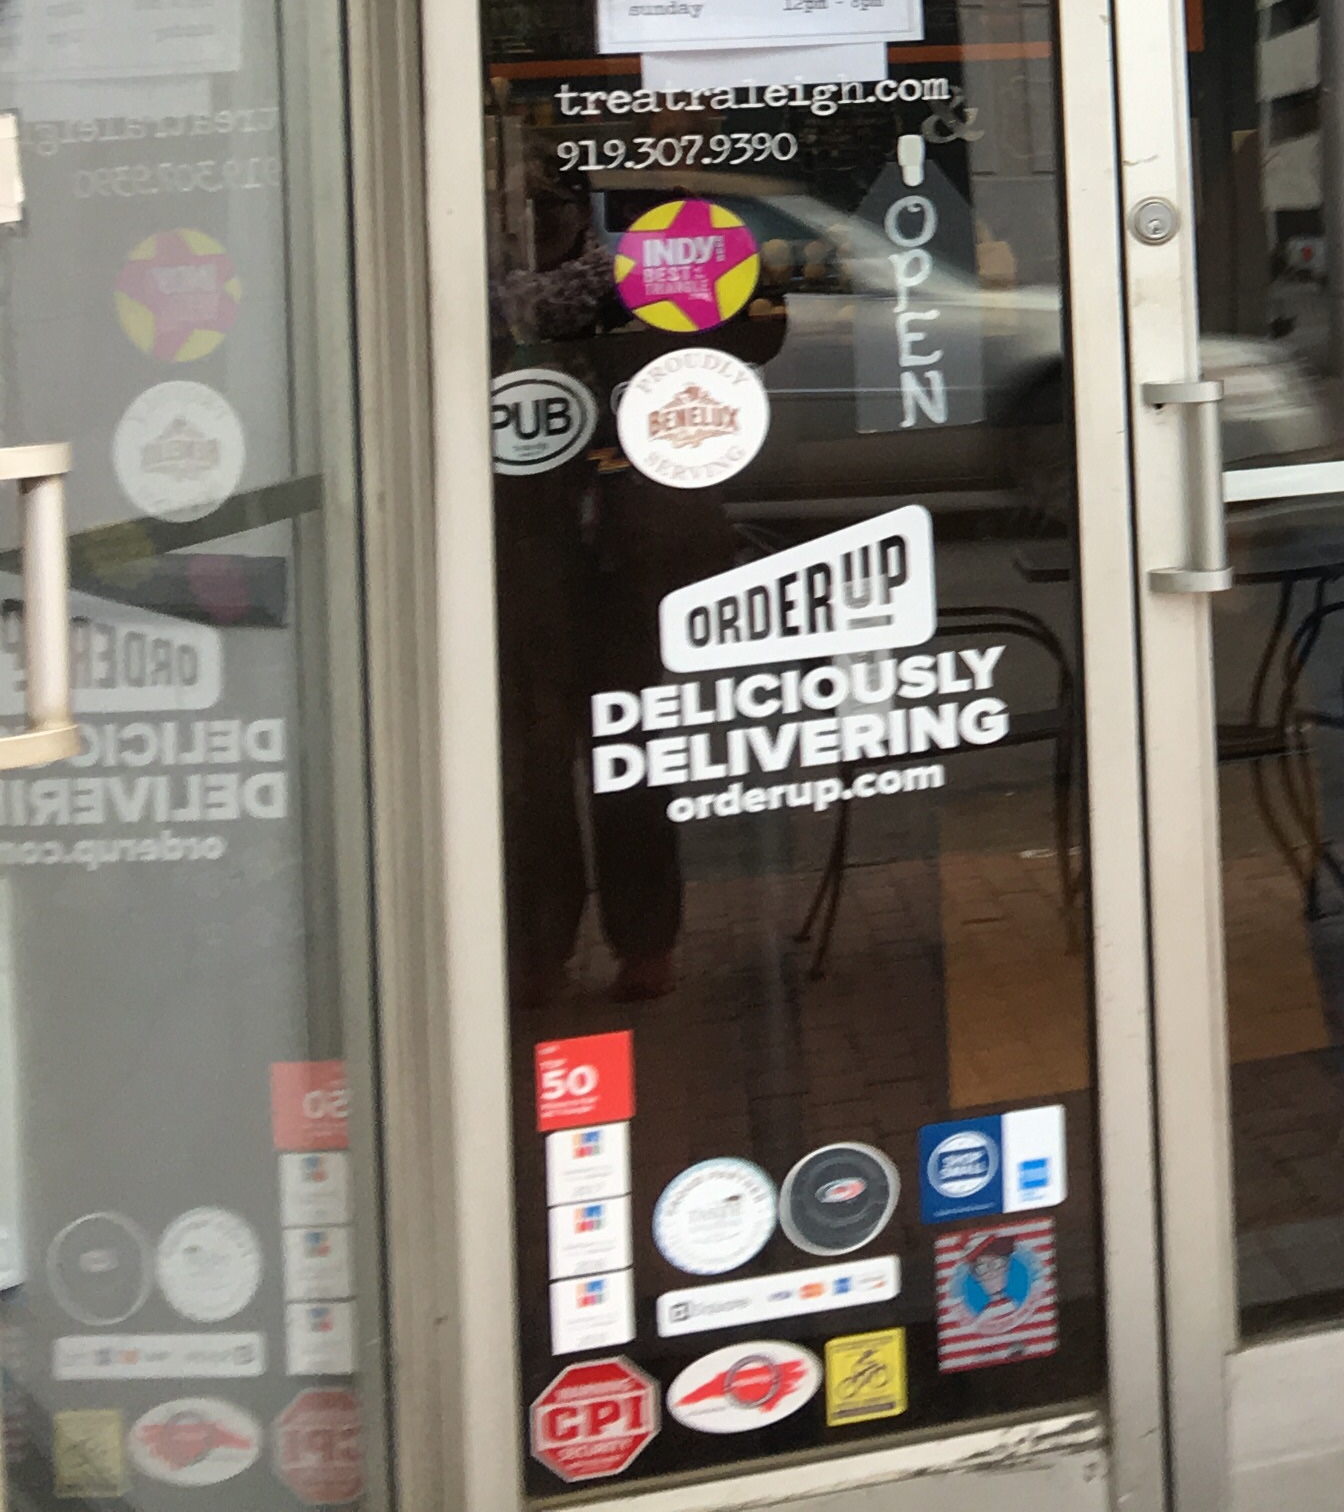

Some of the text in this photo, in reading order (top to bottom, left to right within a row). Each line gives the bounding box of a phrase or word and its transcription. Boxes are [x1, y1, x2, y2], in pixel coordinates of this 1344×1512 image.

[627, 0, 705, 19] sunday
[553, 74, 952, 118] treatraleigh.com
[556, 132, 799, 172] 919.307.9390
[642, 236, 714, 268] INDY
[642, 265, 692, 283] BEST
[883, 194, 949, 430] OPEN
[635, 350, 751, 395] PROUDLY
[647, 403, 742, 438] BENELUX
[643, 443, 748, 481] SERVING
[591, 644, 1007, 739] DELICIOUSLY
[592, 696, 1011, 795] DELIVERING
[665, 763, 946, 824] orderup.com
[540, 1063, 600, 1101] 50
[542, 1394, 644, 1442] CPI
